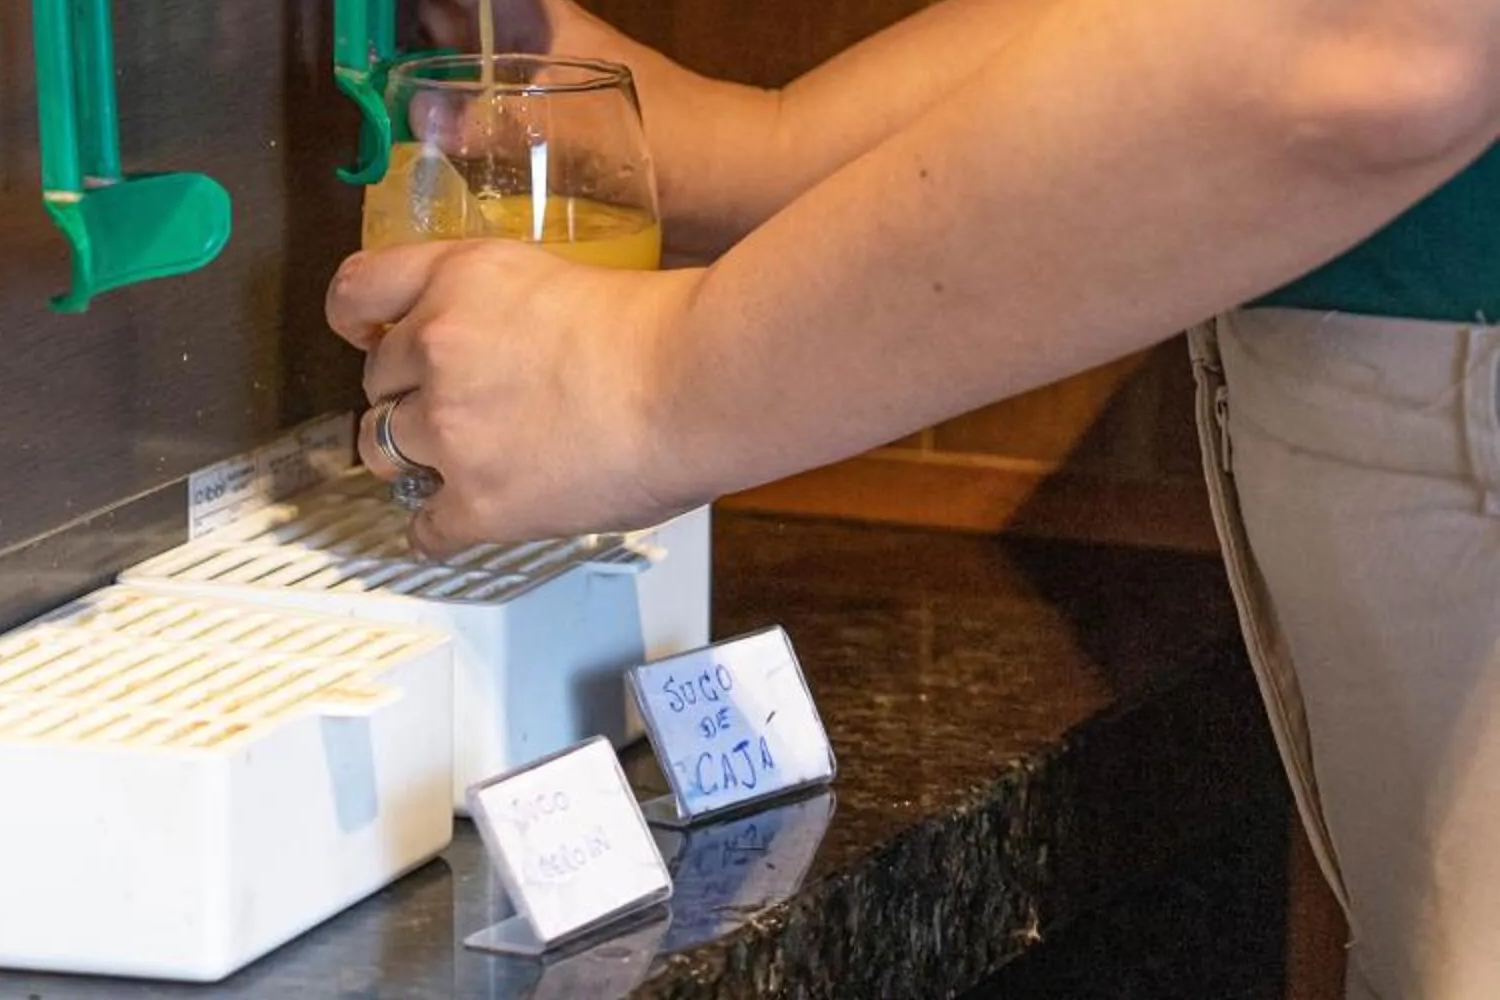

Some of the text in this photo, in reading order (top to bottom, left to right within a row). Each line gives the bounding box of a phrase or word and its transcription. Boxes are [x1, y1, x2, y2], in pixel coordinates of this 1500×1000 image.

[662, 664, 733, 713] SUCO
[700, 707, 731, 738] DE
[510, 790, 570, 831] CO
